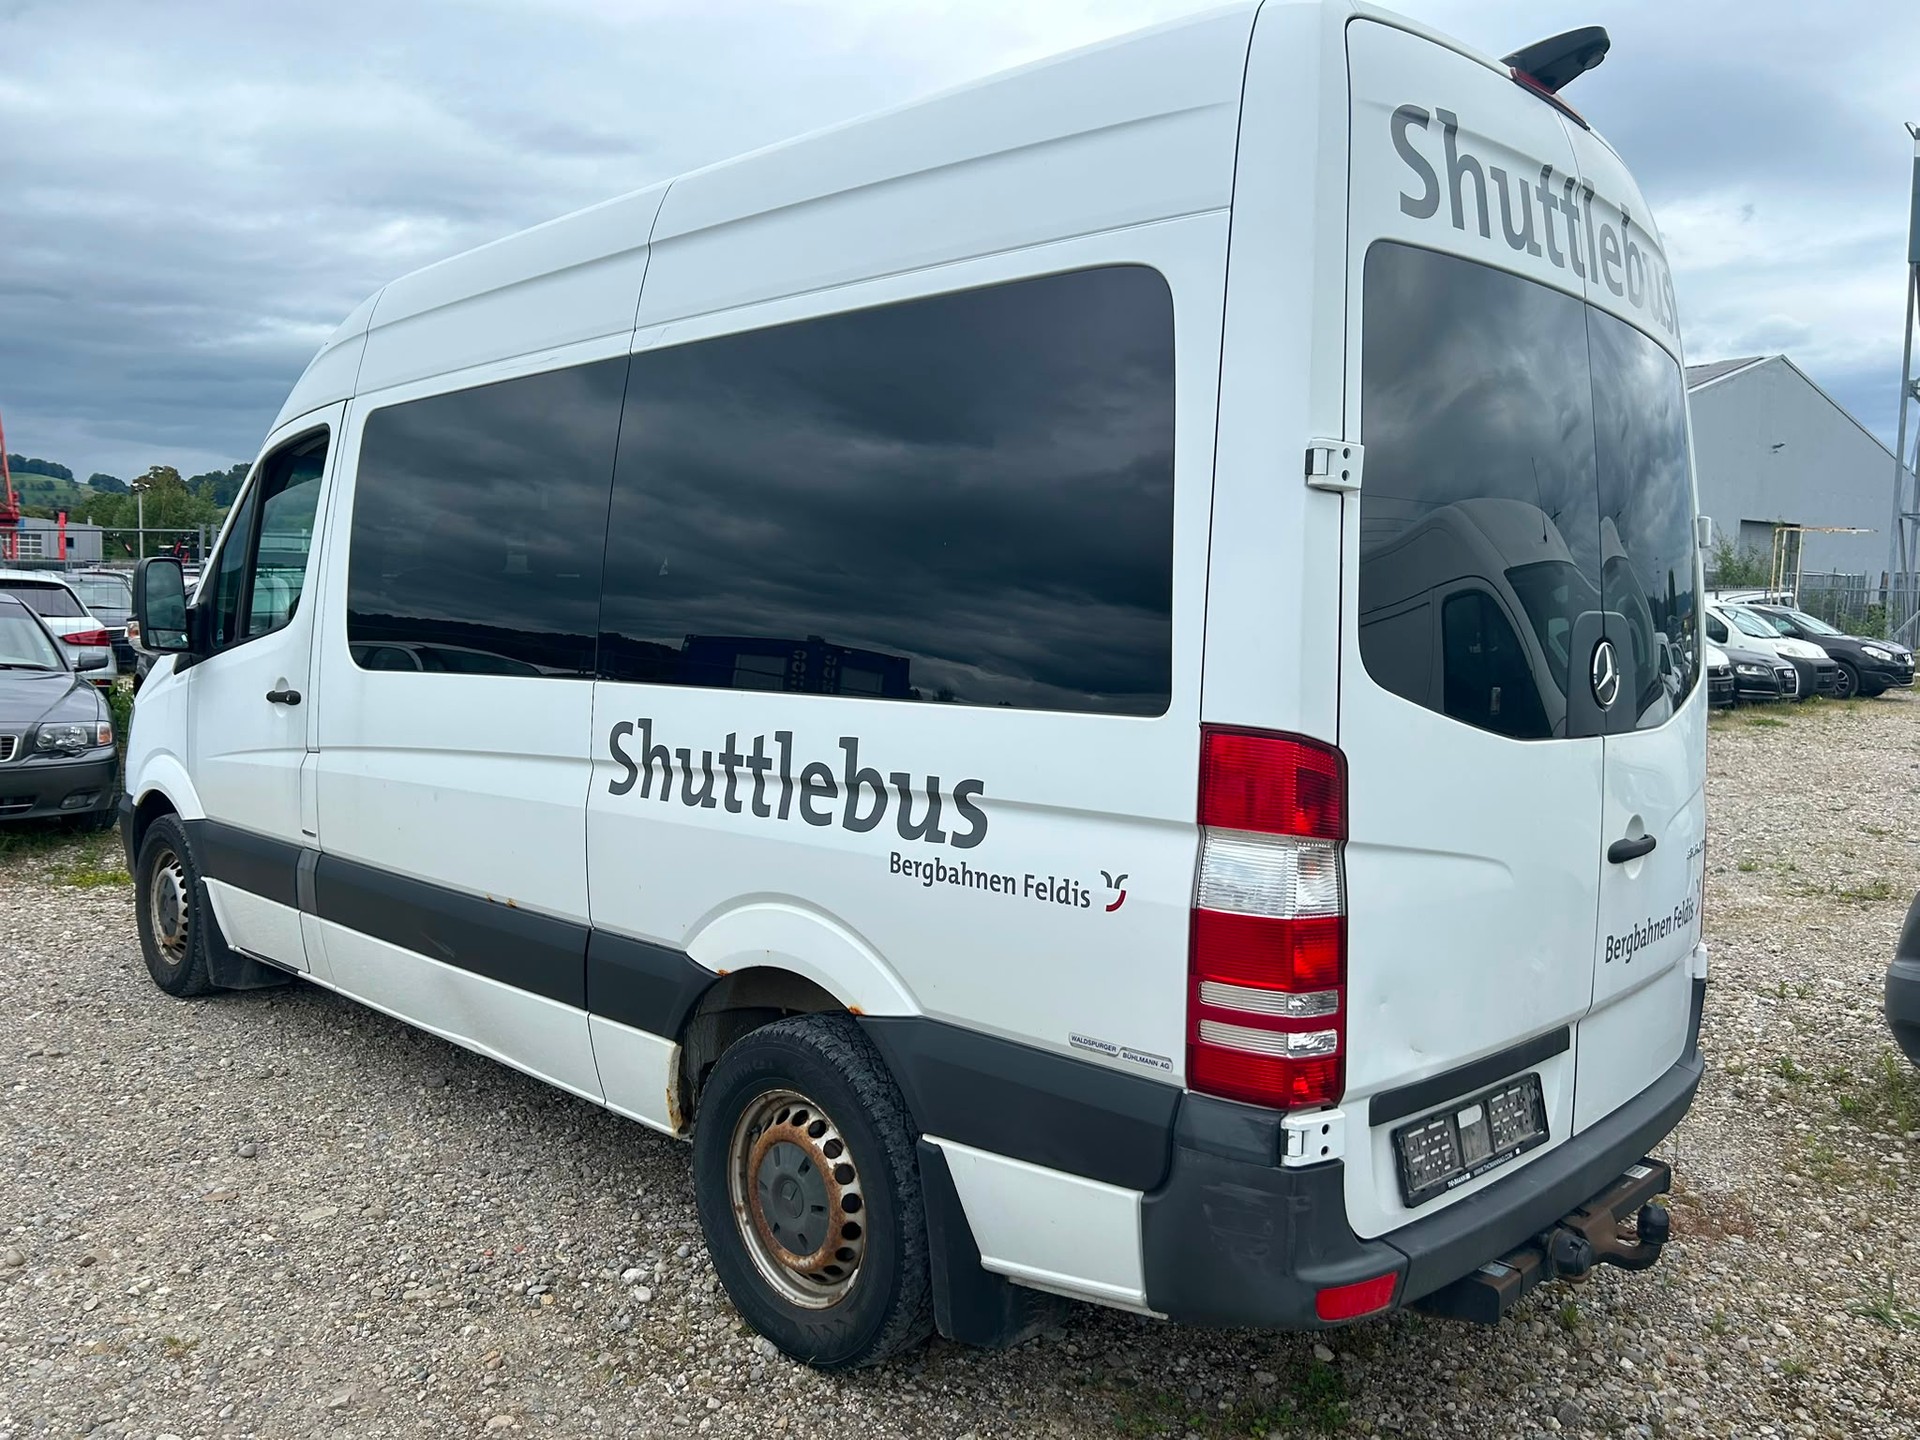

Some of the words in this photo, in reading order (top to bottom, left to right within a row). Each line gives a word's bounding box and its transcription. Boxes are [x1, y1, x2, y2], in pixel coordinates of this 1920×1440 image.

[1390, 104, 1675, 335] Shuttlebus
[608, 718, 988, 848] Shuttlebus
[889, 851, 1016, 896] Bergbahnen
[1023, 875, 1091, 909] Feldis
[1605, 914, 1672, 963] Bergbahnen
[1674, 897, 1694, 931] Feldis
[1071, 1034, 1117, 1053] WALDSPURGER
[1160, 1061, 1170, 1070] AG
